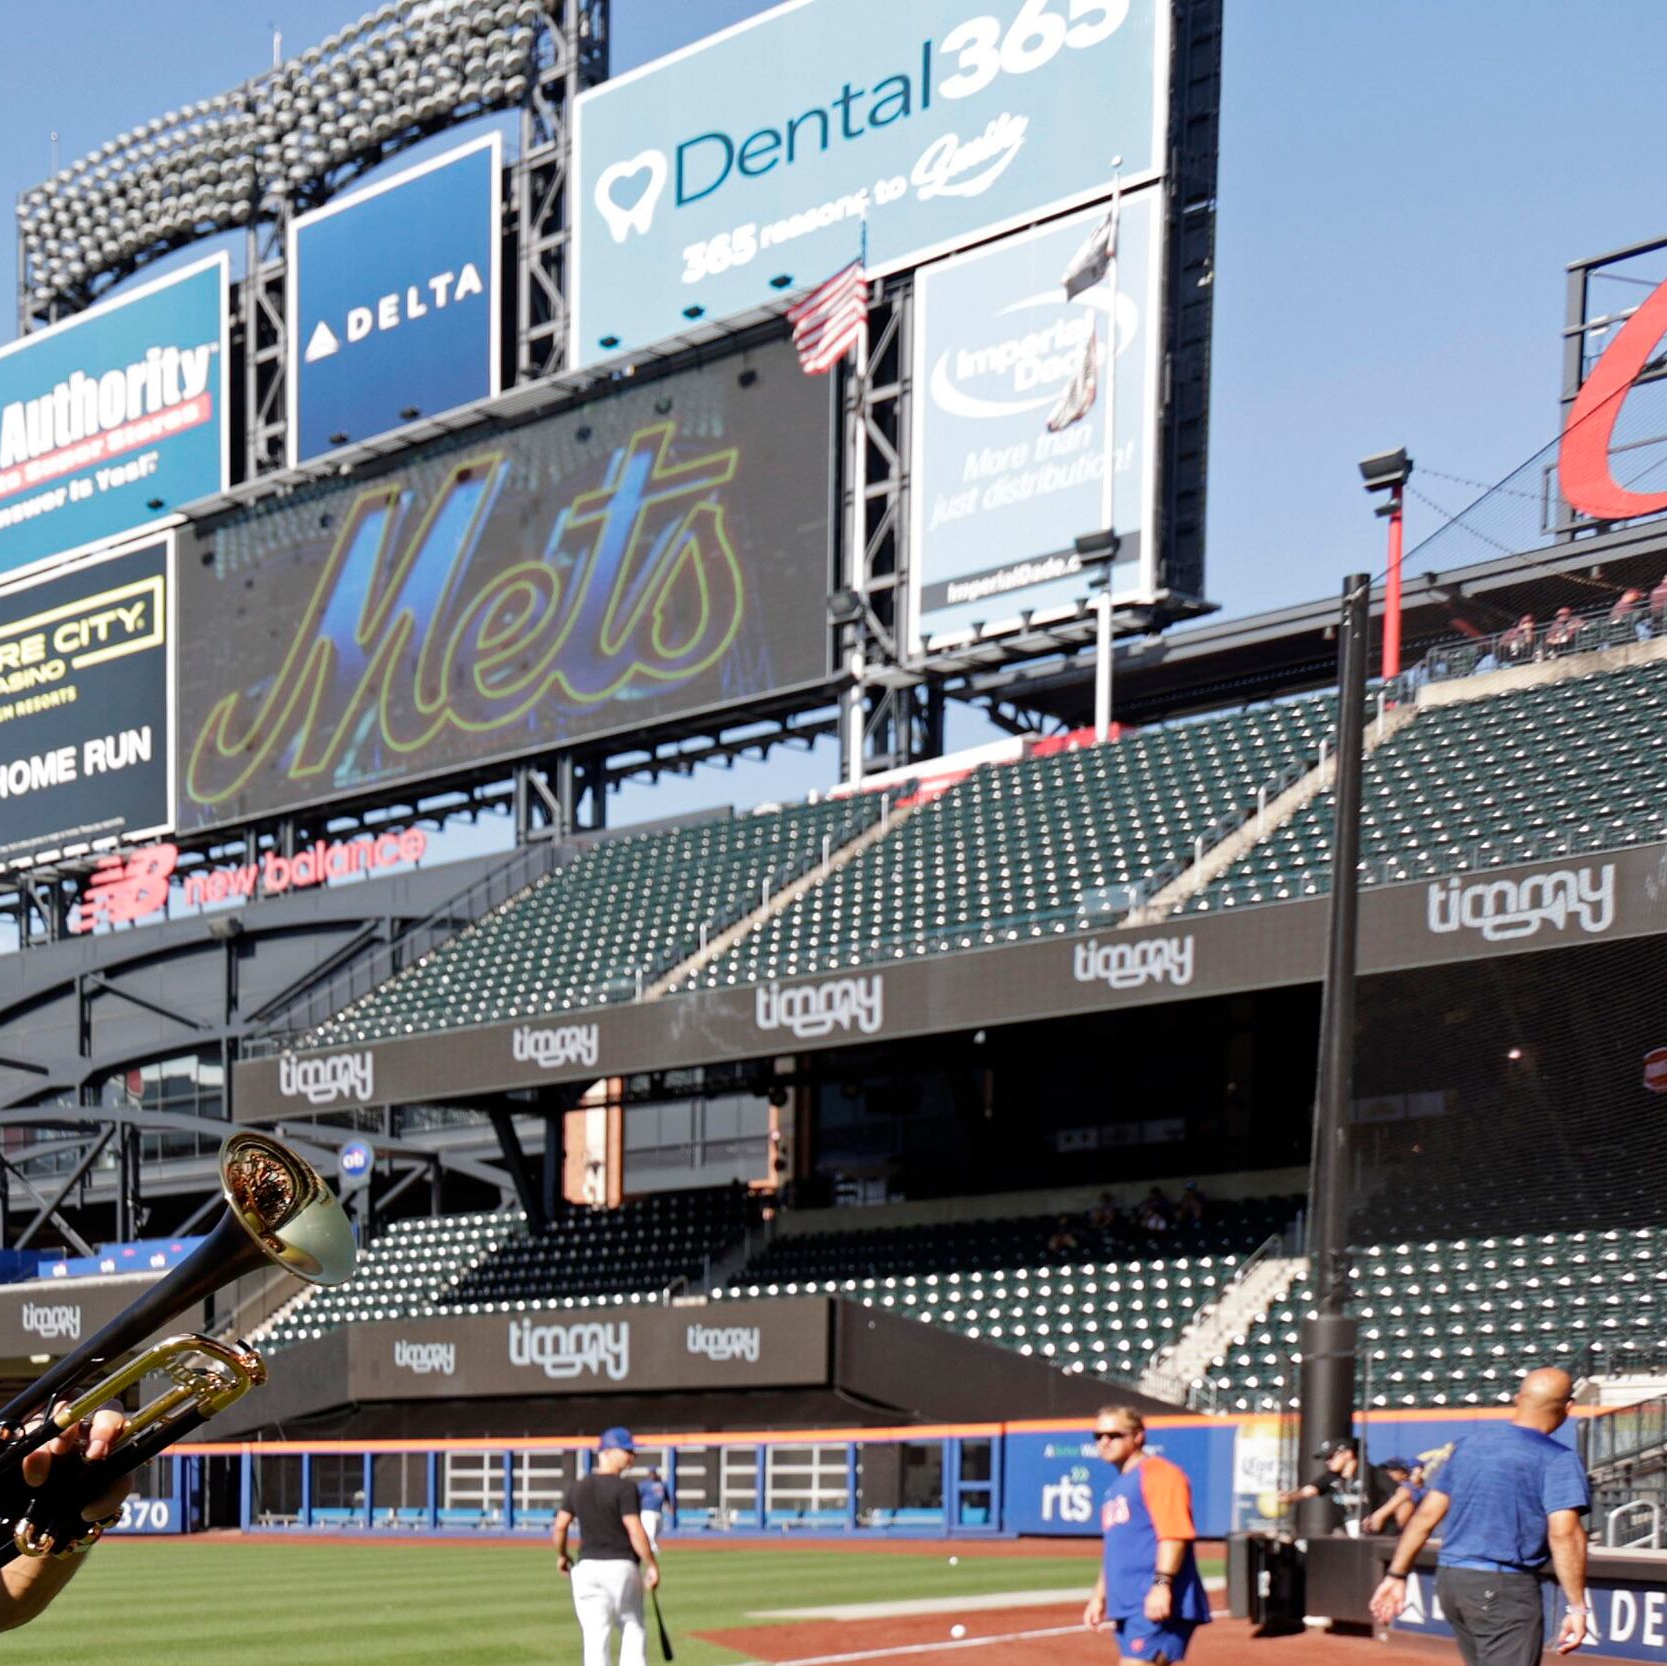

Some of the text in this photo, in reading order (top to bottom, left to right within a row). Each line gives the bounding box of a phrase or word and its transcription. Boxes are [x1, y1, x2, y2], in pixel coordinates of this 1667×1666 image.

[675, 0, 1130, 208] Dental365
[682, 222, 757, 284] 365
[874, 176, 908, 206] to
[346, 262, 484, 347] DELTA
[25, 439, 106, 484] Super
[105, 404, 200, 452] Stores
[963, 440, 1028, 483] More
[927, 484, 979, 531] just
[947, 554, 1081, 604] ImperialDade.c
[53, 601, 145, 653] CITY
[184, 422, 742, 803] Mets
[83, 725, 152, 776] RUN
[183, 862, 261, 906] new
[263, 827, 428, 892] balance
[117, 1501, 169, 1529] 370
[1041, 1474, 1093, 1523] rts
